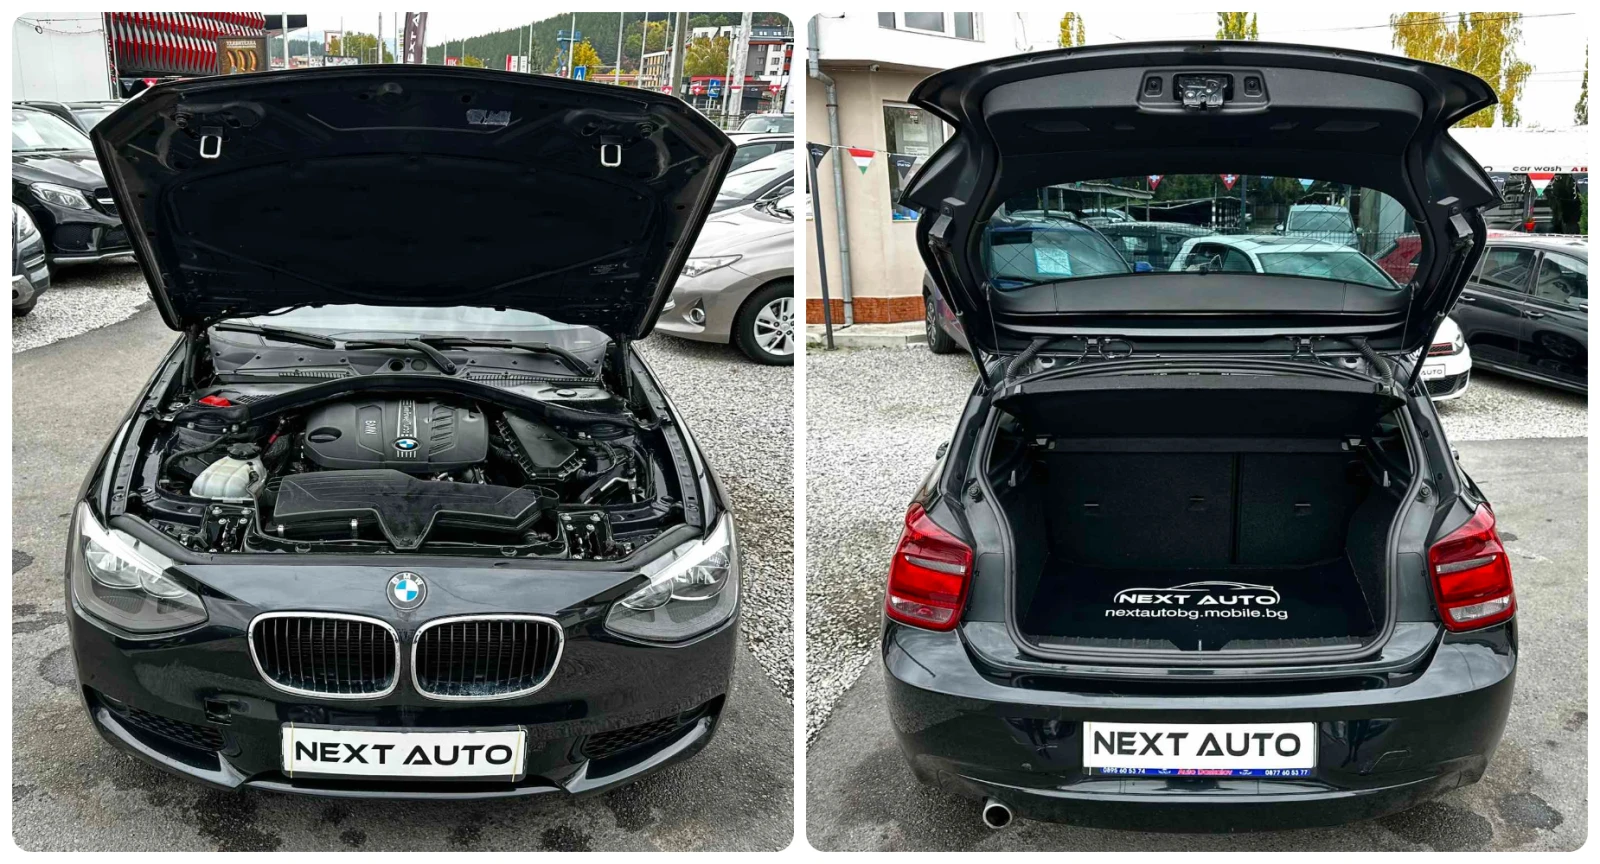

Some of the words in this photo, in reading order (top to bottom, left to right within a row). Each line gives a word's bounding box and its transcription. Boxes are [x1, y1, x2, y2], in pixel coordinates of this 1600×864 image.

[365, 420, 377, 434] BMW
[391, 573, 423, 585] BMW
[1119, 594, 1191, 604] NEXT
[1197, 594, 1278, 605] AUTO
[1105, 608, 1288, 620] nextautobg.mobile.bg
[1094, 730, 1189, 756] NEXT
[1196, 732, 1301, 757] AUTO
[295, 740, 395, 765] NEXT
[402, 744, 513, 766] AUTO
